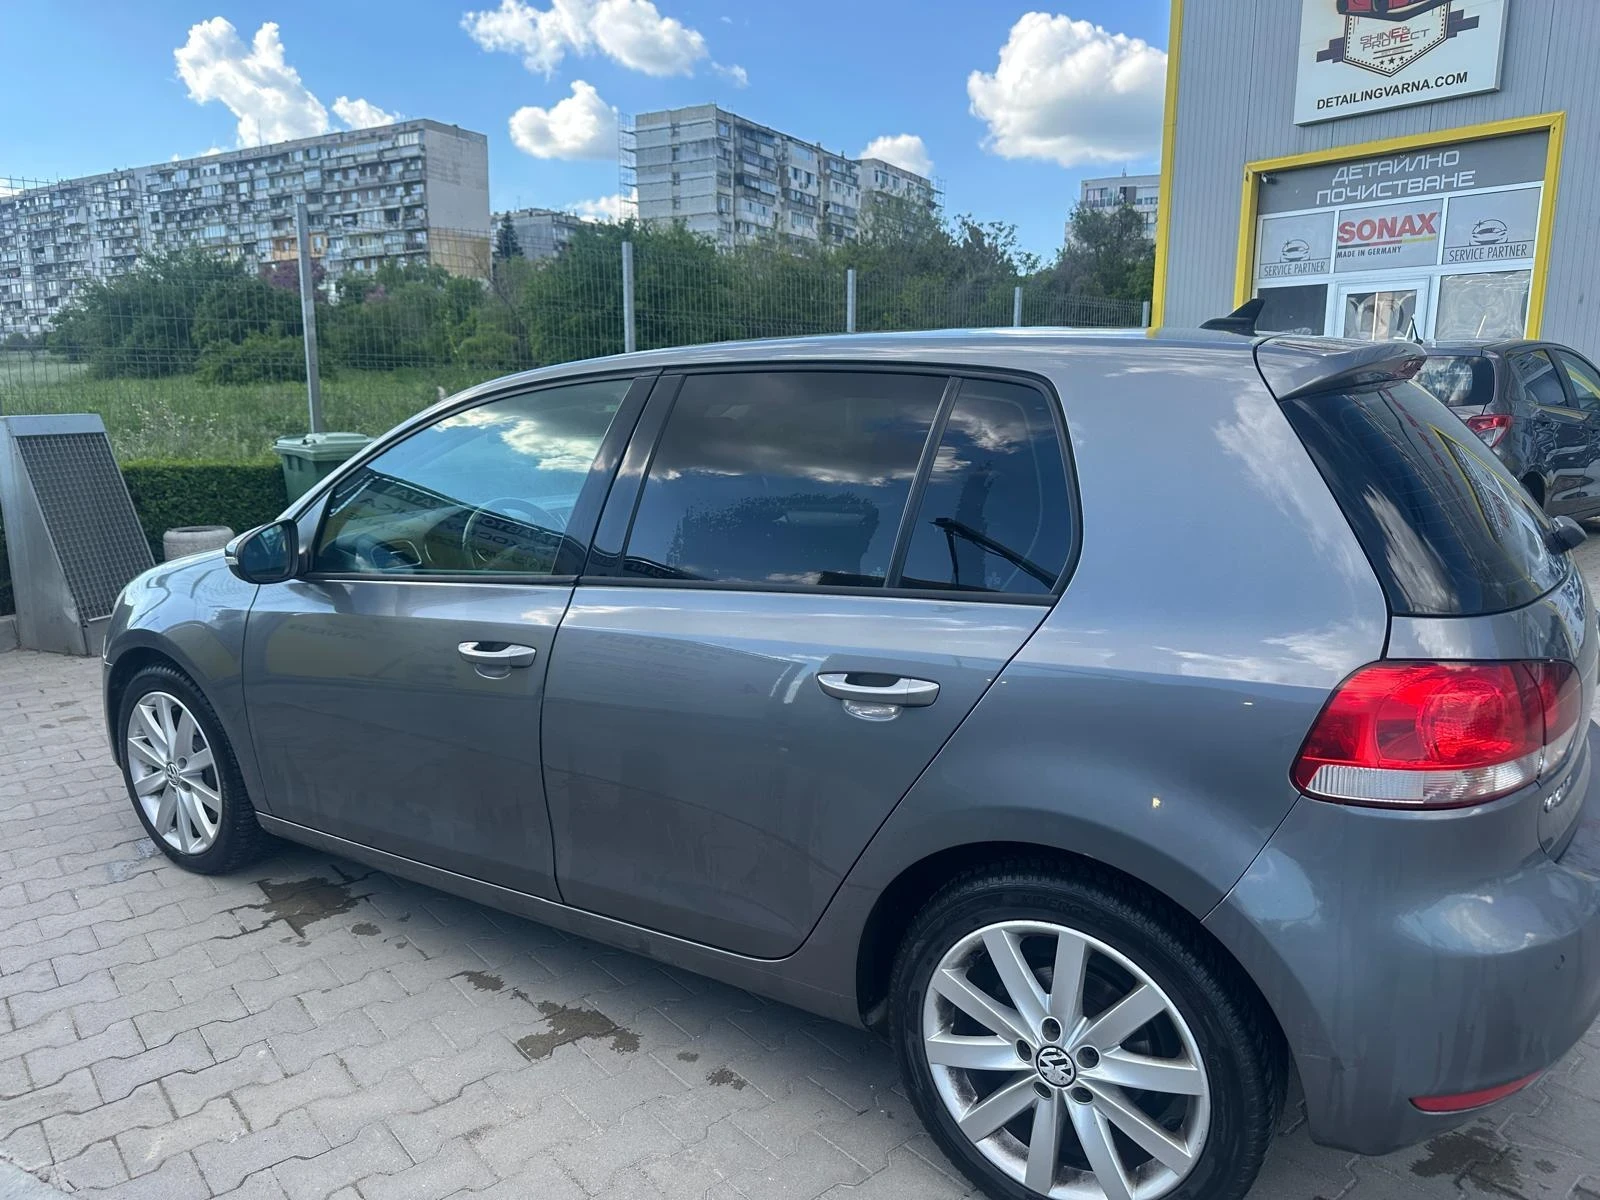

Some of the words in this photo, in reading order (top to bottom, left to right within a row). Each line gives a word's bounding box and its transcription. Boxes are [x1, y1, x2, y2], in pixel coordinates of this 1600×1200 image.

[1362, 29, 1430, 52] PROTECT
[1317, 71, 1468, 110] DETAILINGVARNA.COM
[1332, 150, 1460, 186] ДЕТАЙЛНО
[1316, 170, 1476, 205] ПОЧИСТВАНЕ
[1337, 212, 1438, 244] SONAX
[1336, 251, 1355, 259] MADE
[1357, 249, 1365, 257] IN
[1368, 246, 1401, 256] GERMANY
[1449, 247, 1484, 262] SERVICE
[1487, 244, 1527, 259] PARTNER
[1264, 263, 1291, 277] SERVICE
[1294, 261, 1326, 274] PARTNER
